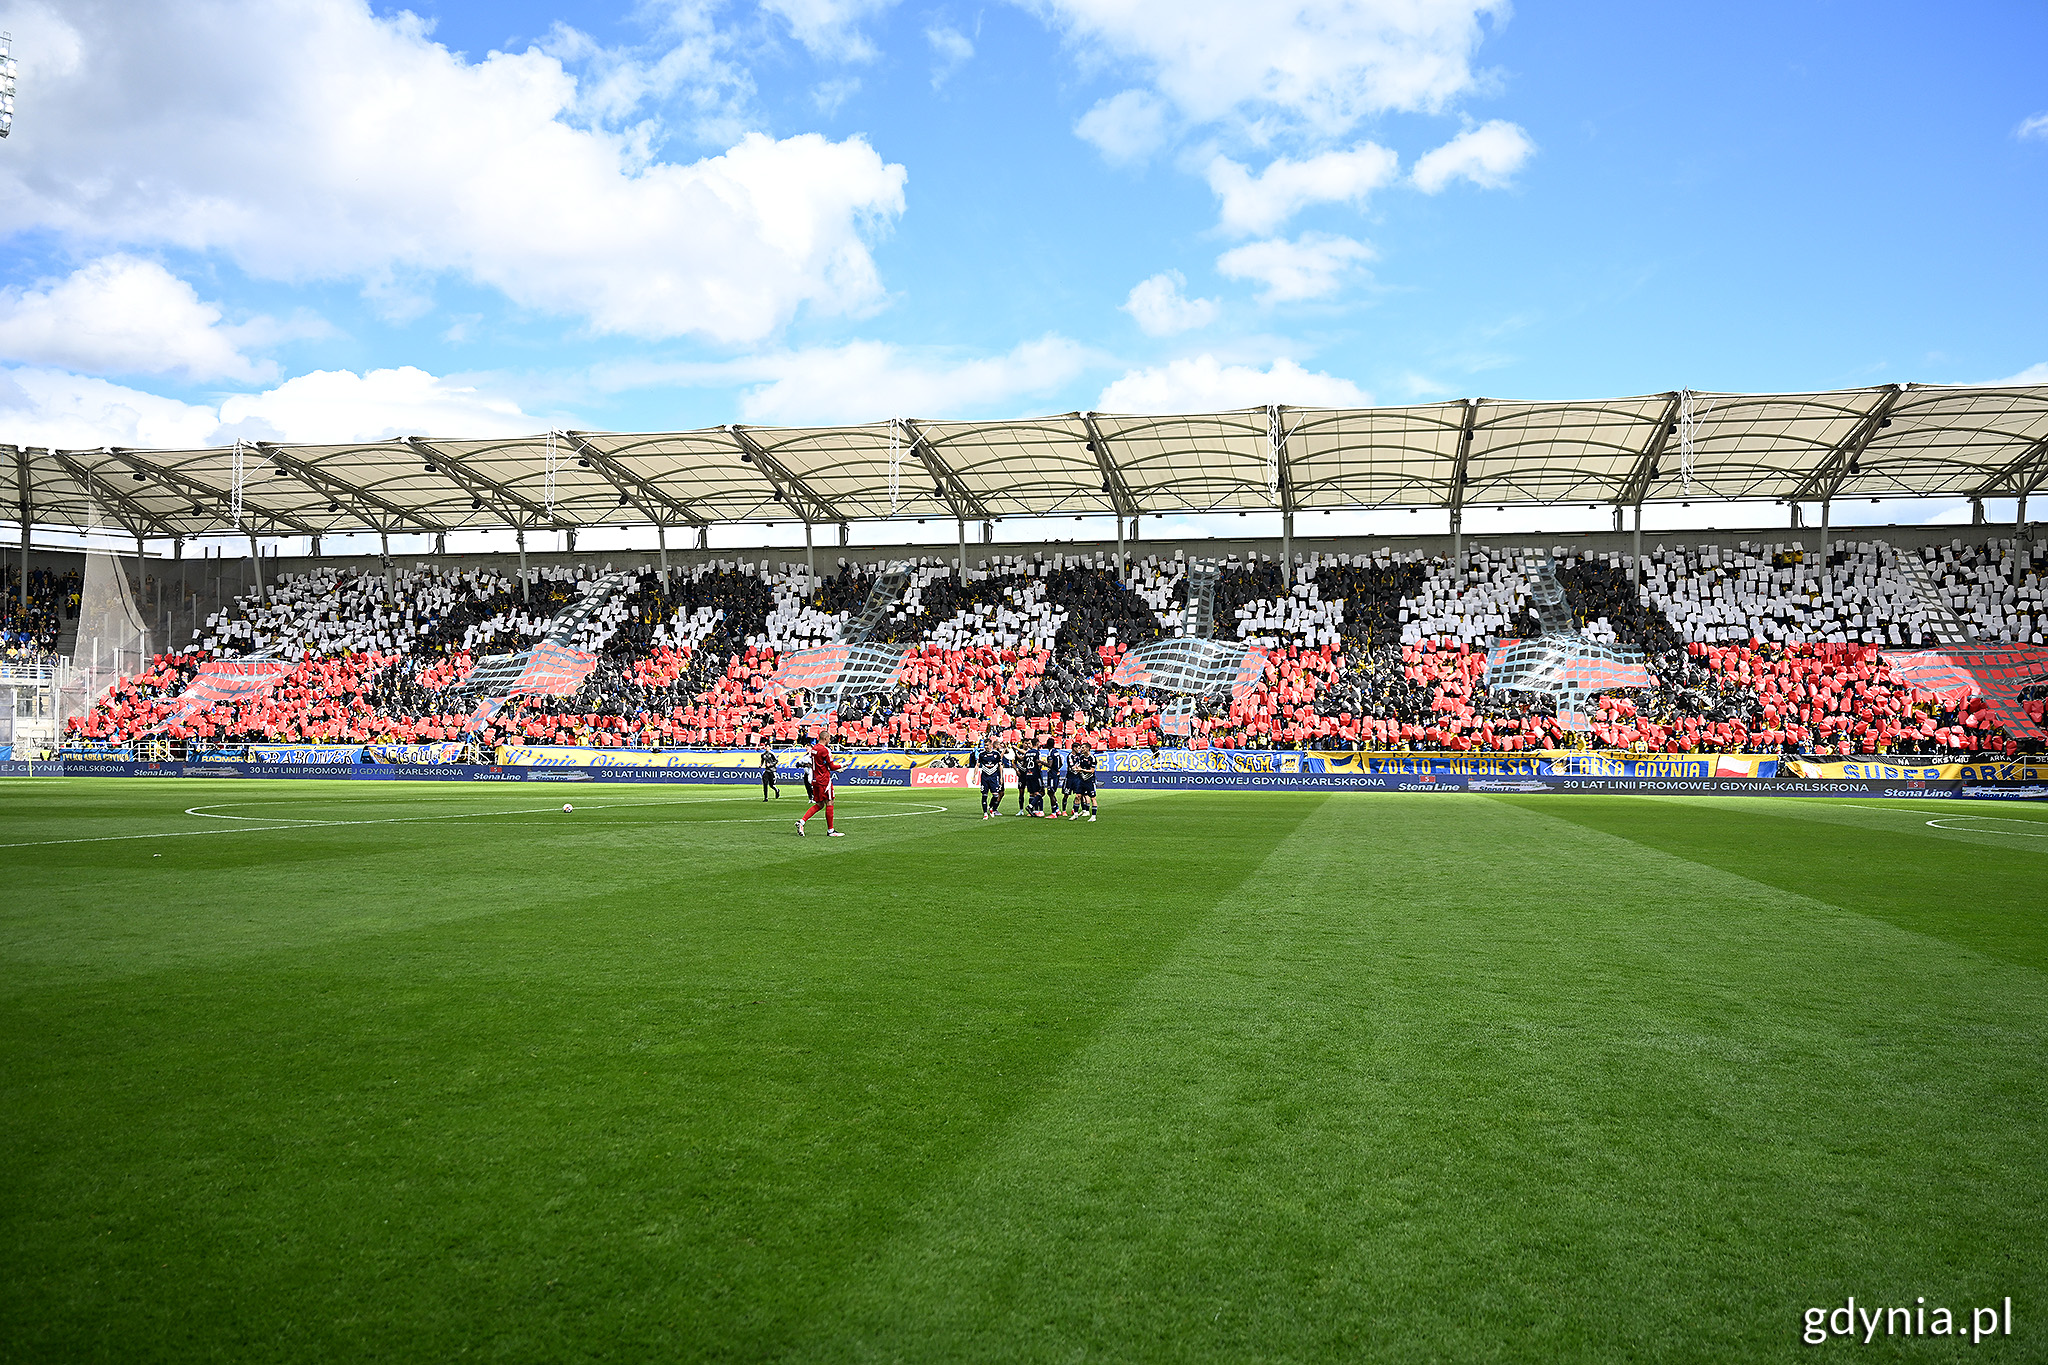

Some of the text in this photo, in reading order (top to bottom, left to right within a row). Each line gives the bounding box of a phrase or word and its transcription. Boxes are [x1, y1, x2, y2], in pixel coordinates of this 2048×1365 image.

[1234, 755, 1274, 773] SAM
[1450, 759, 1540, 775] NIEBIESCY
[1579, 758, 1700, 777] ARKA GDYNIA
[303, 767, 358, 775] PROMOWEJ
[360, 768, 464, 776] GDYNIA-KARLSKRONA
[601, 770, 613, 778] 30
[615, 770, 634, 778] LAT
[636, 770, 658, 778] LINII
[660, 770, 720, 779] PROMOWEJ
[917, 773, 959, 784] Betclic
[1112, 776, 1386, 786] 30 LAT LINII PROMOWEJ GDYNIA-KARLSKRONA
[1563, 781, 1869, 792] 30 LAT LINII PROMOWEJ GDYNIA-KARLSKRONA
